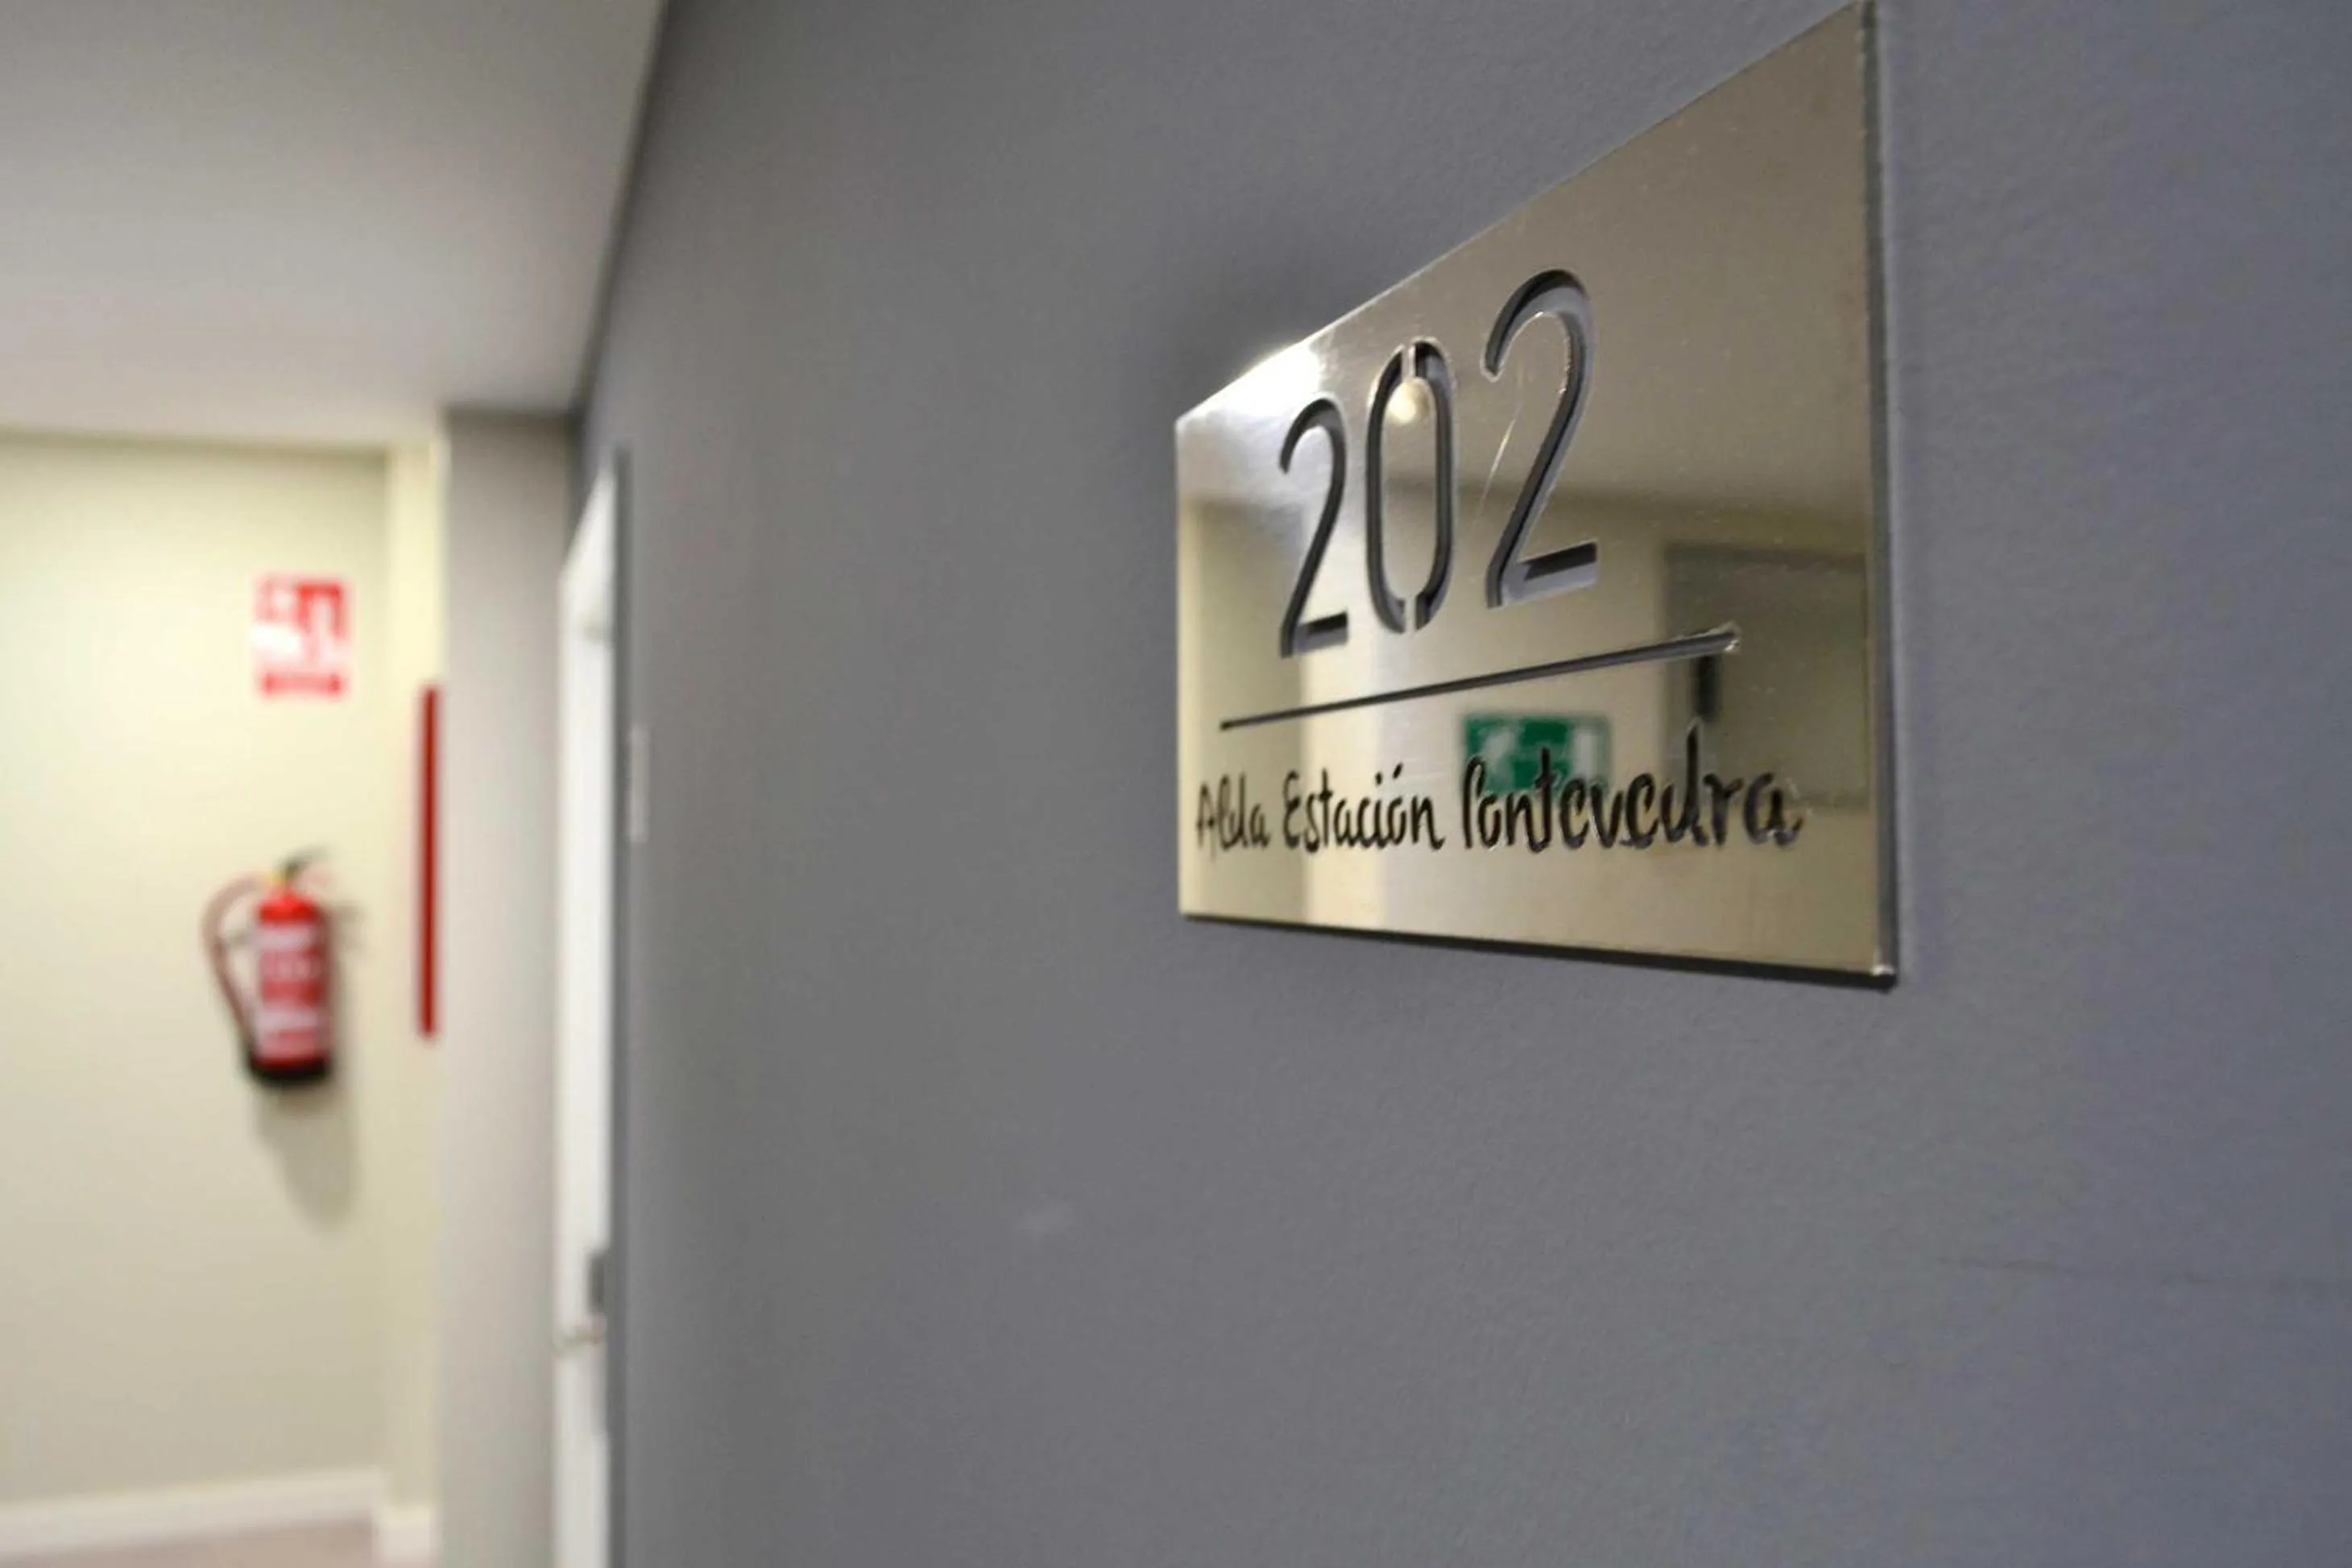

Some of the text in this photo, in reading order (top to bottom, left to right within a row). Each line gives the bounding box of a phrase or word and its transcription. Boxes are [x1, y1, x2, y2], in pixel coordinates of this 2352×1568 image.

[1277, 267, 1599, 659] 202
[1196, 722, 1803, 854] Alda Estación Pontevedra
